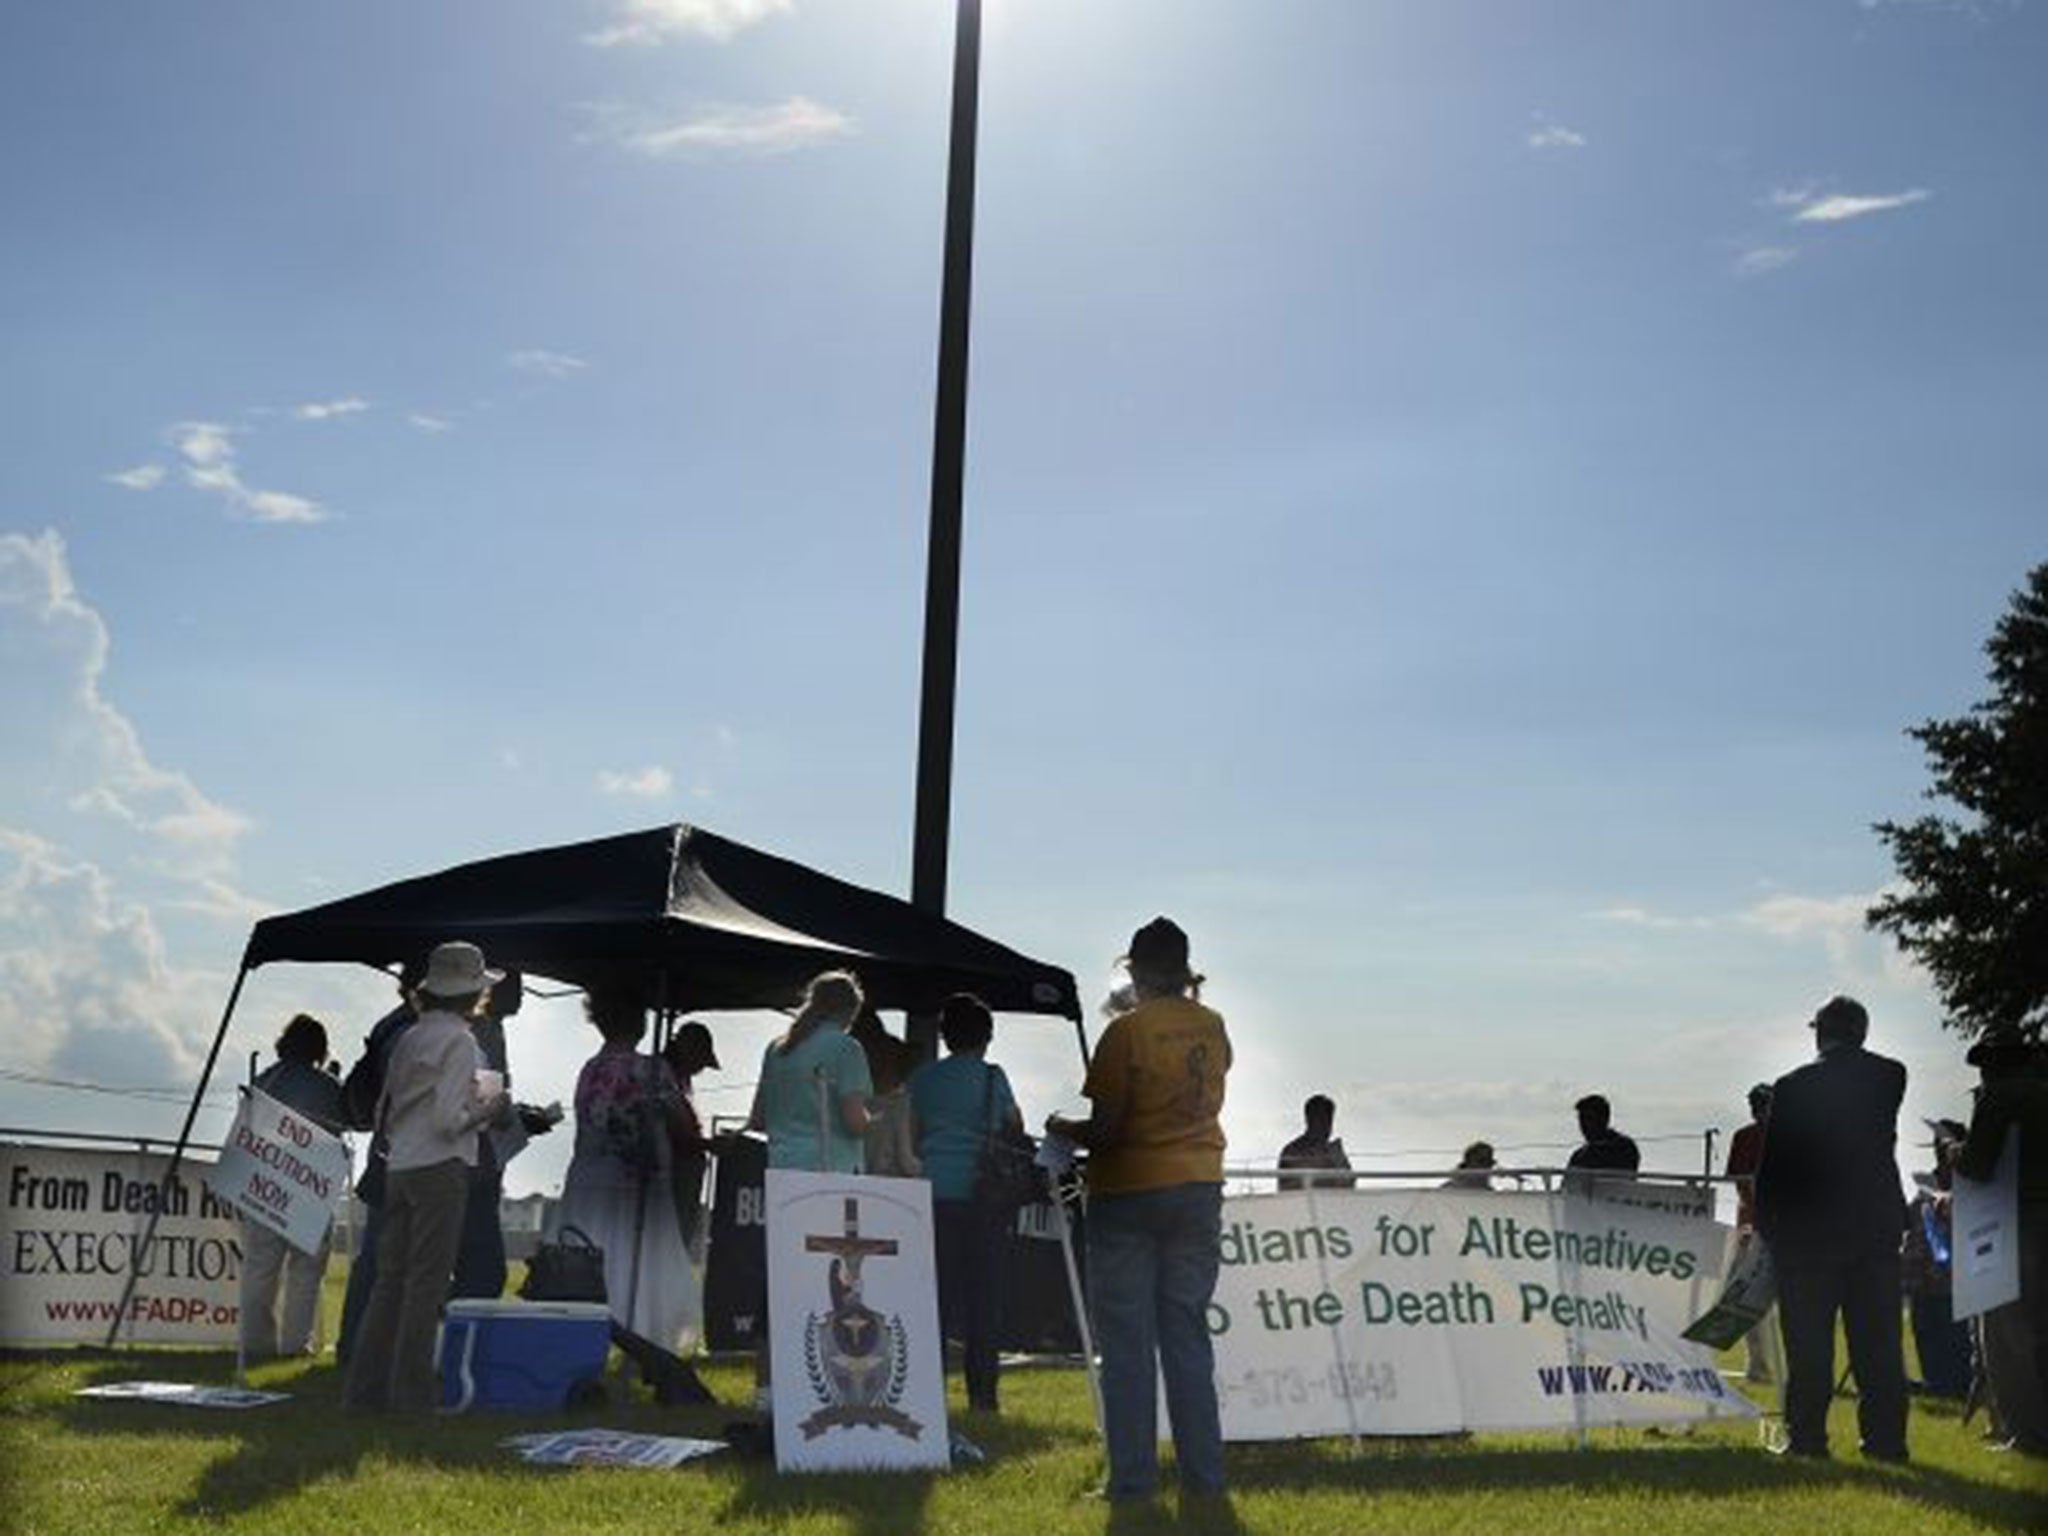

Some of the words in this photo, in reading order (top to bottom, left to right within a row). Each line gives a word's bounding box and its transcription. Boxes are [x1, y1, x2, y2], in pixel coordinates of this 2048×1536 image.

[278, 1115, 313, 1149] END
[8, 1165, 90, 1212] From
[101, 1171, 189, 1217] Death
[235, 1126, 333, 1199] EXECUTIONS
[1374, 1214, 1436, 1257] for
[1458, 1215, 1698, 1281] Alternatives
[1255, 1287, 1344, 1331] the
[1362, 1281, 1494, 1326] Death
[1518, 1282, 1649, 1341] Penalty
